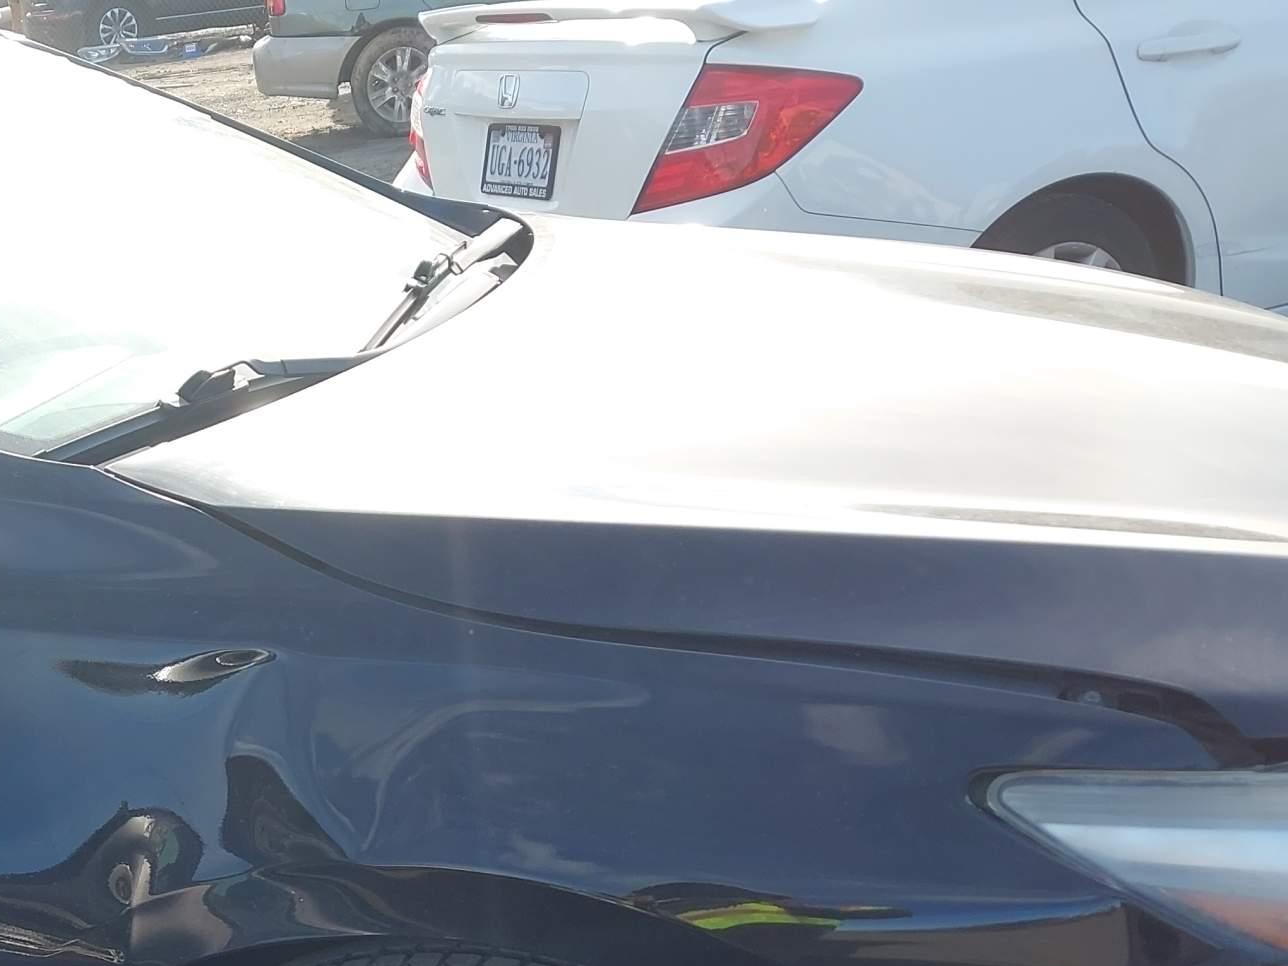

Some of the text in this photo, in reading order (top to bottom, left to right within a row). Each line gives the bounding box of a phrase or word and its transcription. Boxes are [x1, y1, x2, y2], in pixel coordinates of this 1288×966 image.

[506, 130, 538, 143] VIRGINIA
[482, 183, 513, 194] ADVANCED
[513, 186, 529, 196] AUTO
[529, 187, 547, 198] SALES
